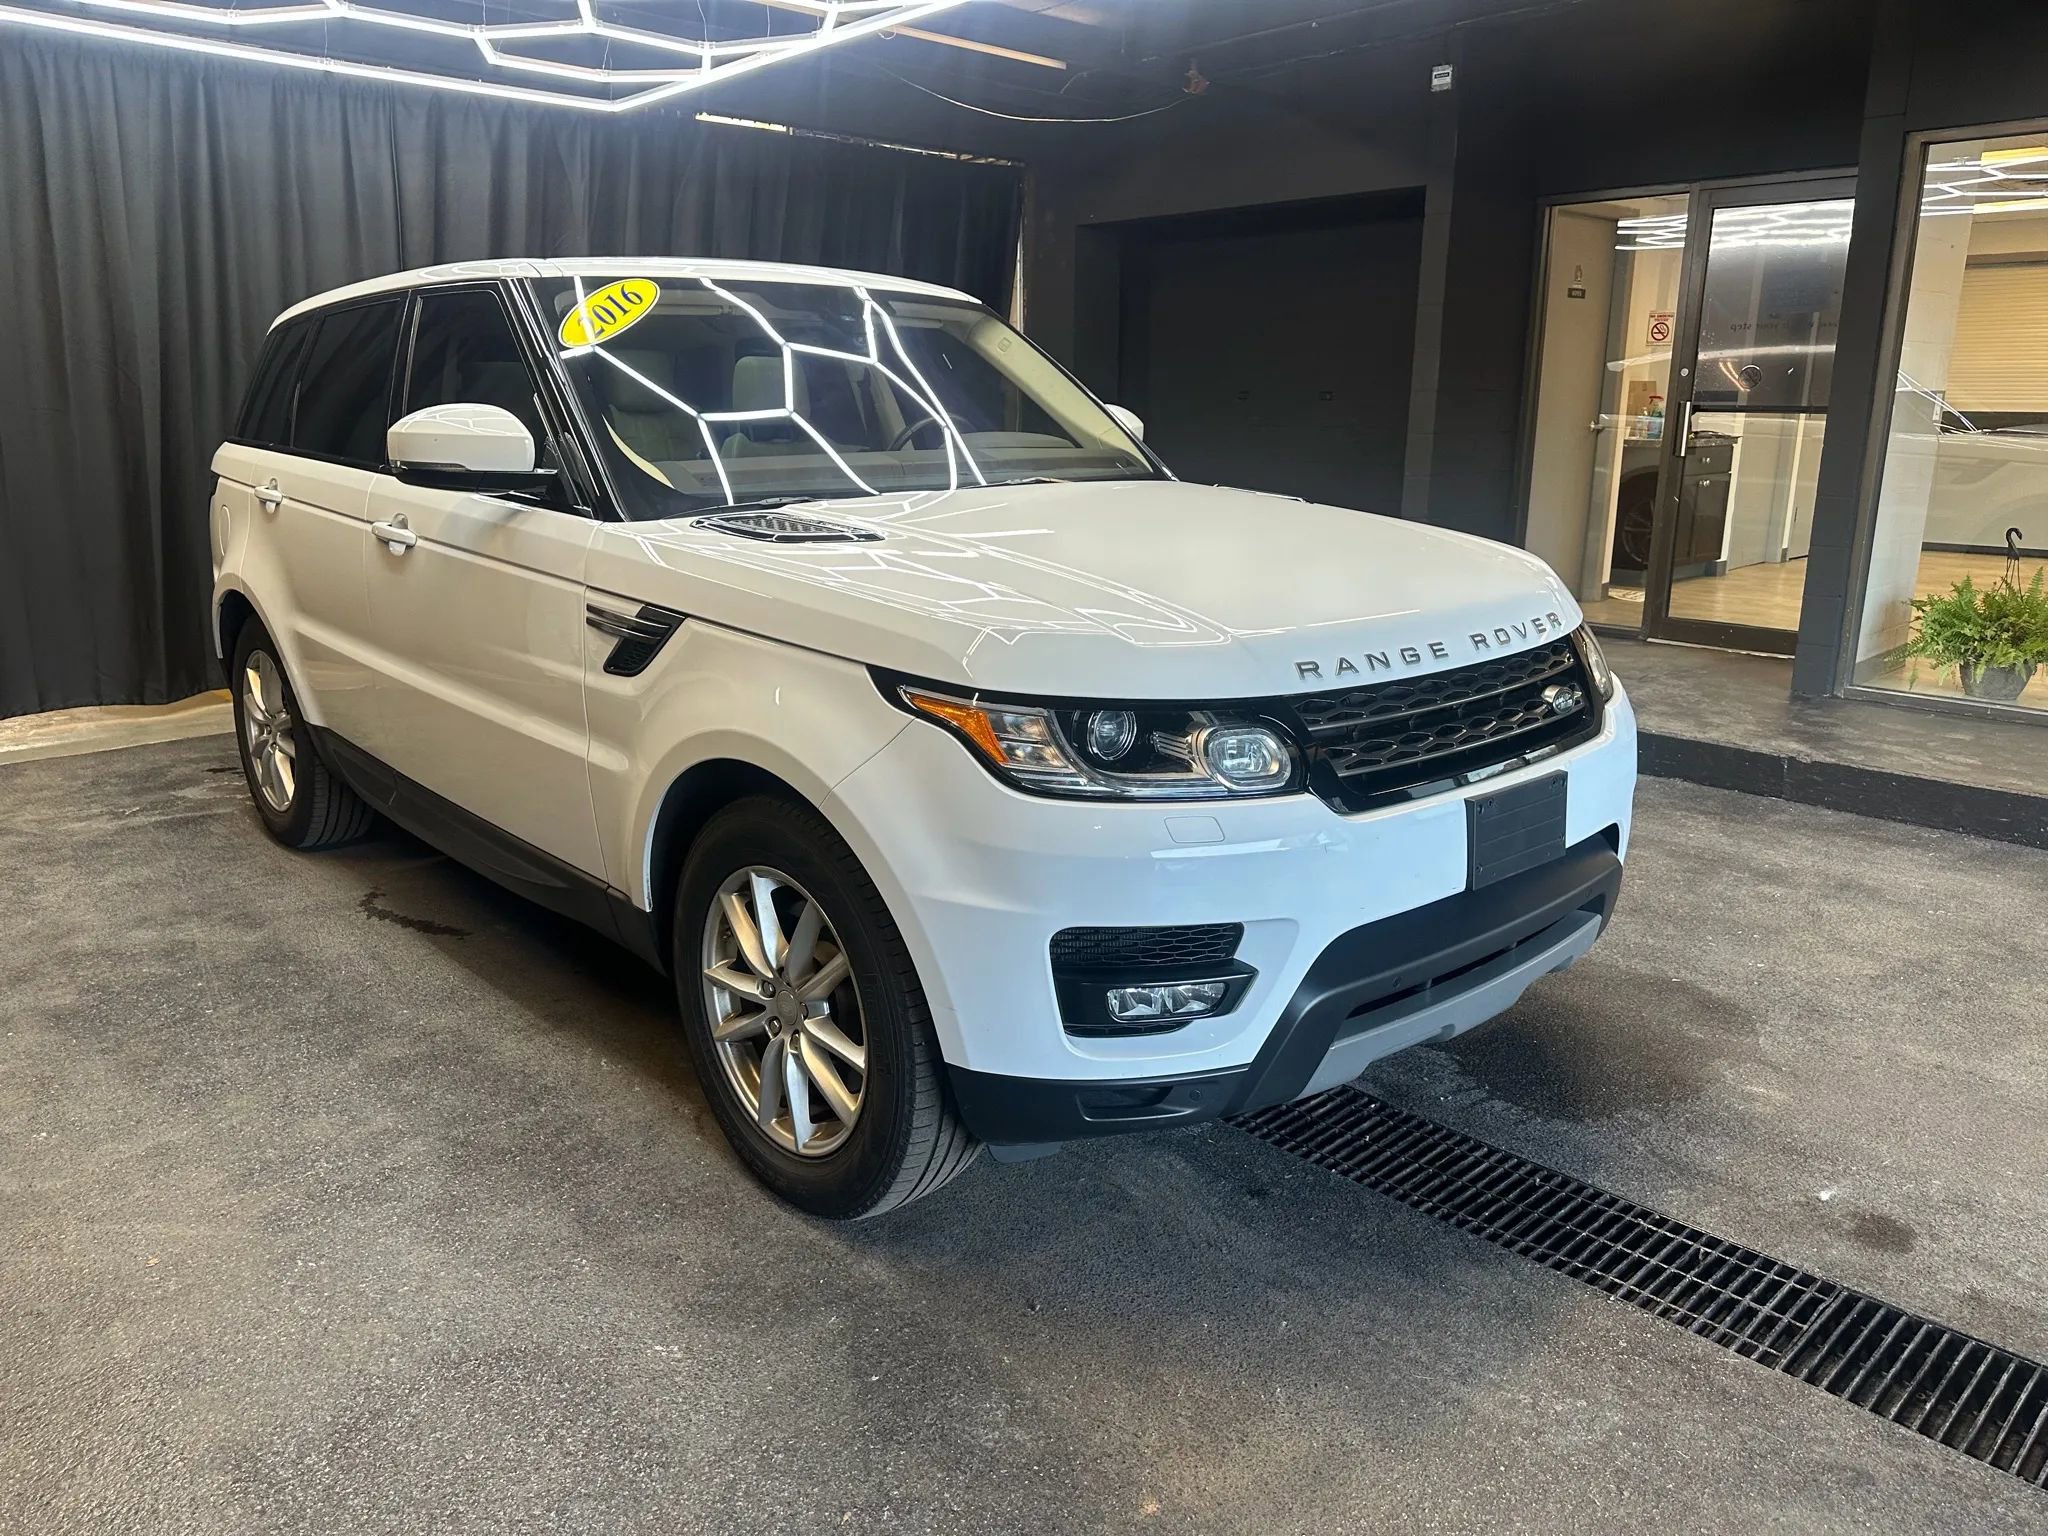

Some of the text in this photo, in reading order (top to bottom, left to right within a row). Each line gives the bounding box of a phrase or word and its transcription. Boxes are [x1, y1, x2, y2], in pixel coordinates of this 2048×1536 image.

[577, 284, 643, 338] 2016
[1294, 611, 1563, 681] RANGE ROVER
